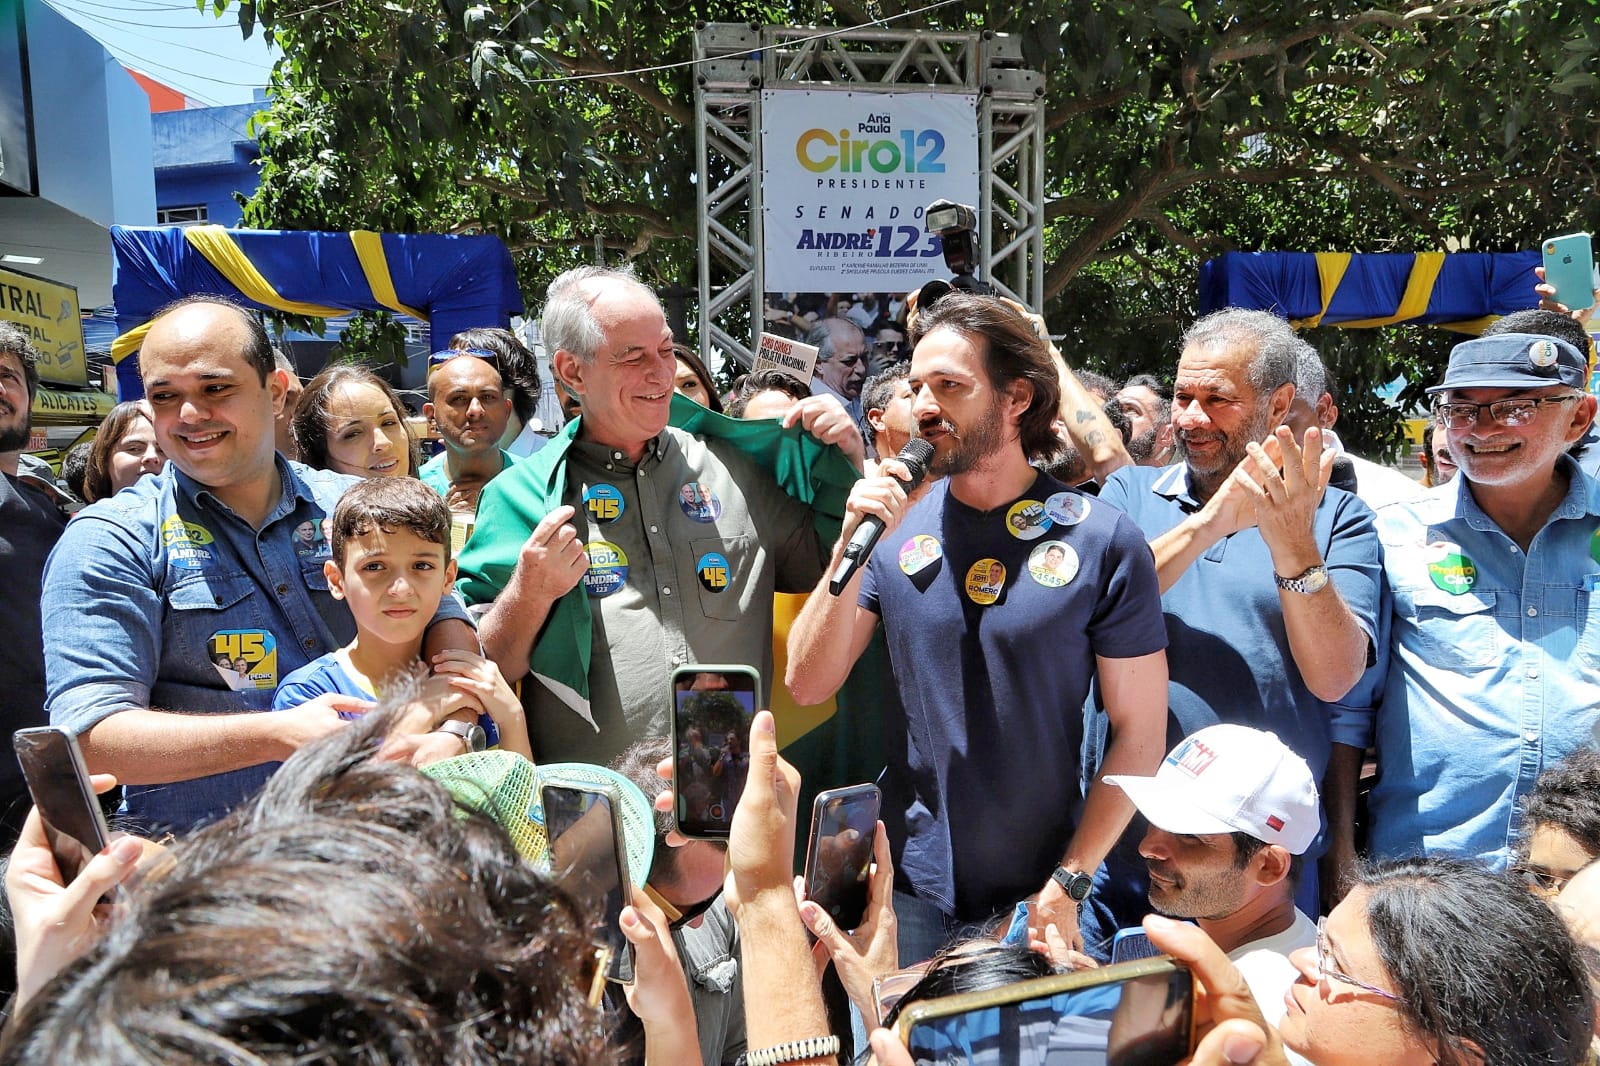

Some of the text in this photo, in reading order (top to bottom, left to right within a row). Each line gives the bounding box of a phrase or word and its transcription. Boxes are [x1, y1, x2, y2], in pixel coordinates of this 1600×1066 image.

[867, 113, 891, 124] Ana
[858, 123, 891, 134] Paula
[817, 178, 926, 189] PRESIDENTE
[41, 394, 97, 411] ALICATES
[588, 498, 620, 519] 45
[1022, 503, 1042, 517] 45
[703, 566, 728, 587] 45
[1443, 575, 1474, 585] Ciro
[968, 584, 999, 596] ROMERO
[215, 633, 266, 663] 45
